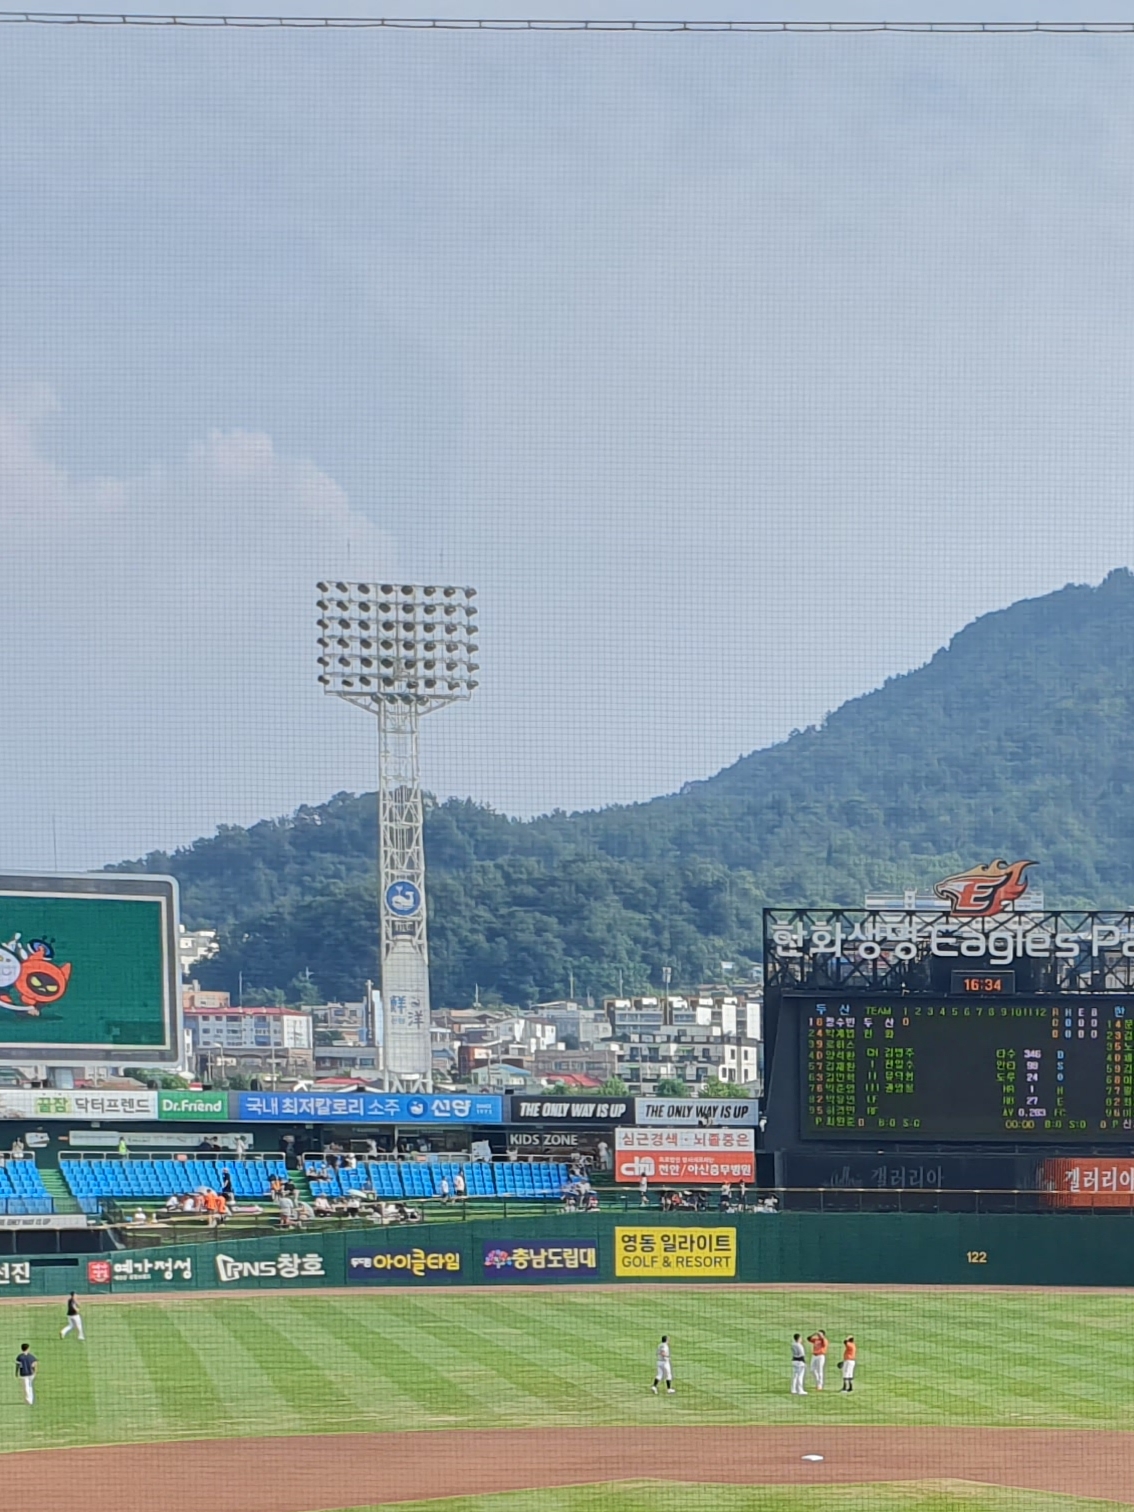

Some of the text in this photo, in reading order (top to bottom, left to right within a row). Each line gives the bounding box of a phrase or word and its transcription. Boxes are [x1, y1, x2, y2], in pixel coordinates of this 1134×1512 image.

[772, 922, 919, 965] 한화생명
[931, 926, 1080, 965] Eagles
[964, 977, 1002, 991] 16:34
[865, 1006, 892, 1016] TEAM
[75, 1097, 151, 1114] 닥터프렌드
[162, 1099, 223, 1114] Dr.Friend
[246, 1097, 400, 1117] 국내 최저칼로리 소주
[430, 1099, 472, 1117] 선양
[520, 1102, 626, 1117] THE ONLY WAY IS UP
[645, 1104, 749, 1120] THE ONLY WAY IS UP
[509, 1133, 579, 1146] KIDS ZONE
[620, 1234, 732, 1252] 영동 일라이트
[373, 1248, 460, 1276] 아이클타임
[511, 1247, 597, 1269] 충남도립대
[622, 1255, 731, 1269] GOLF & RESORT
[966, 1251, 988, 1264] 122
[113, 1258, 192, 1280] 예가정성
